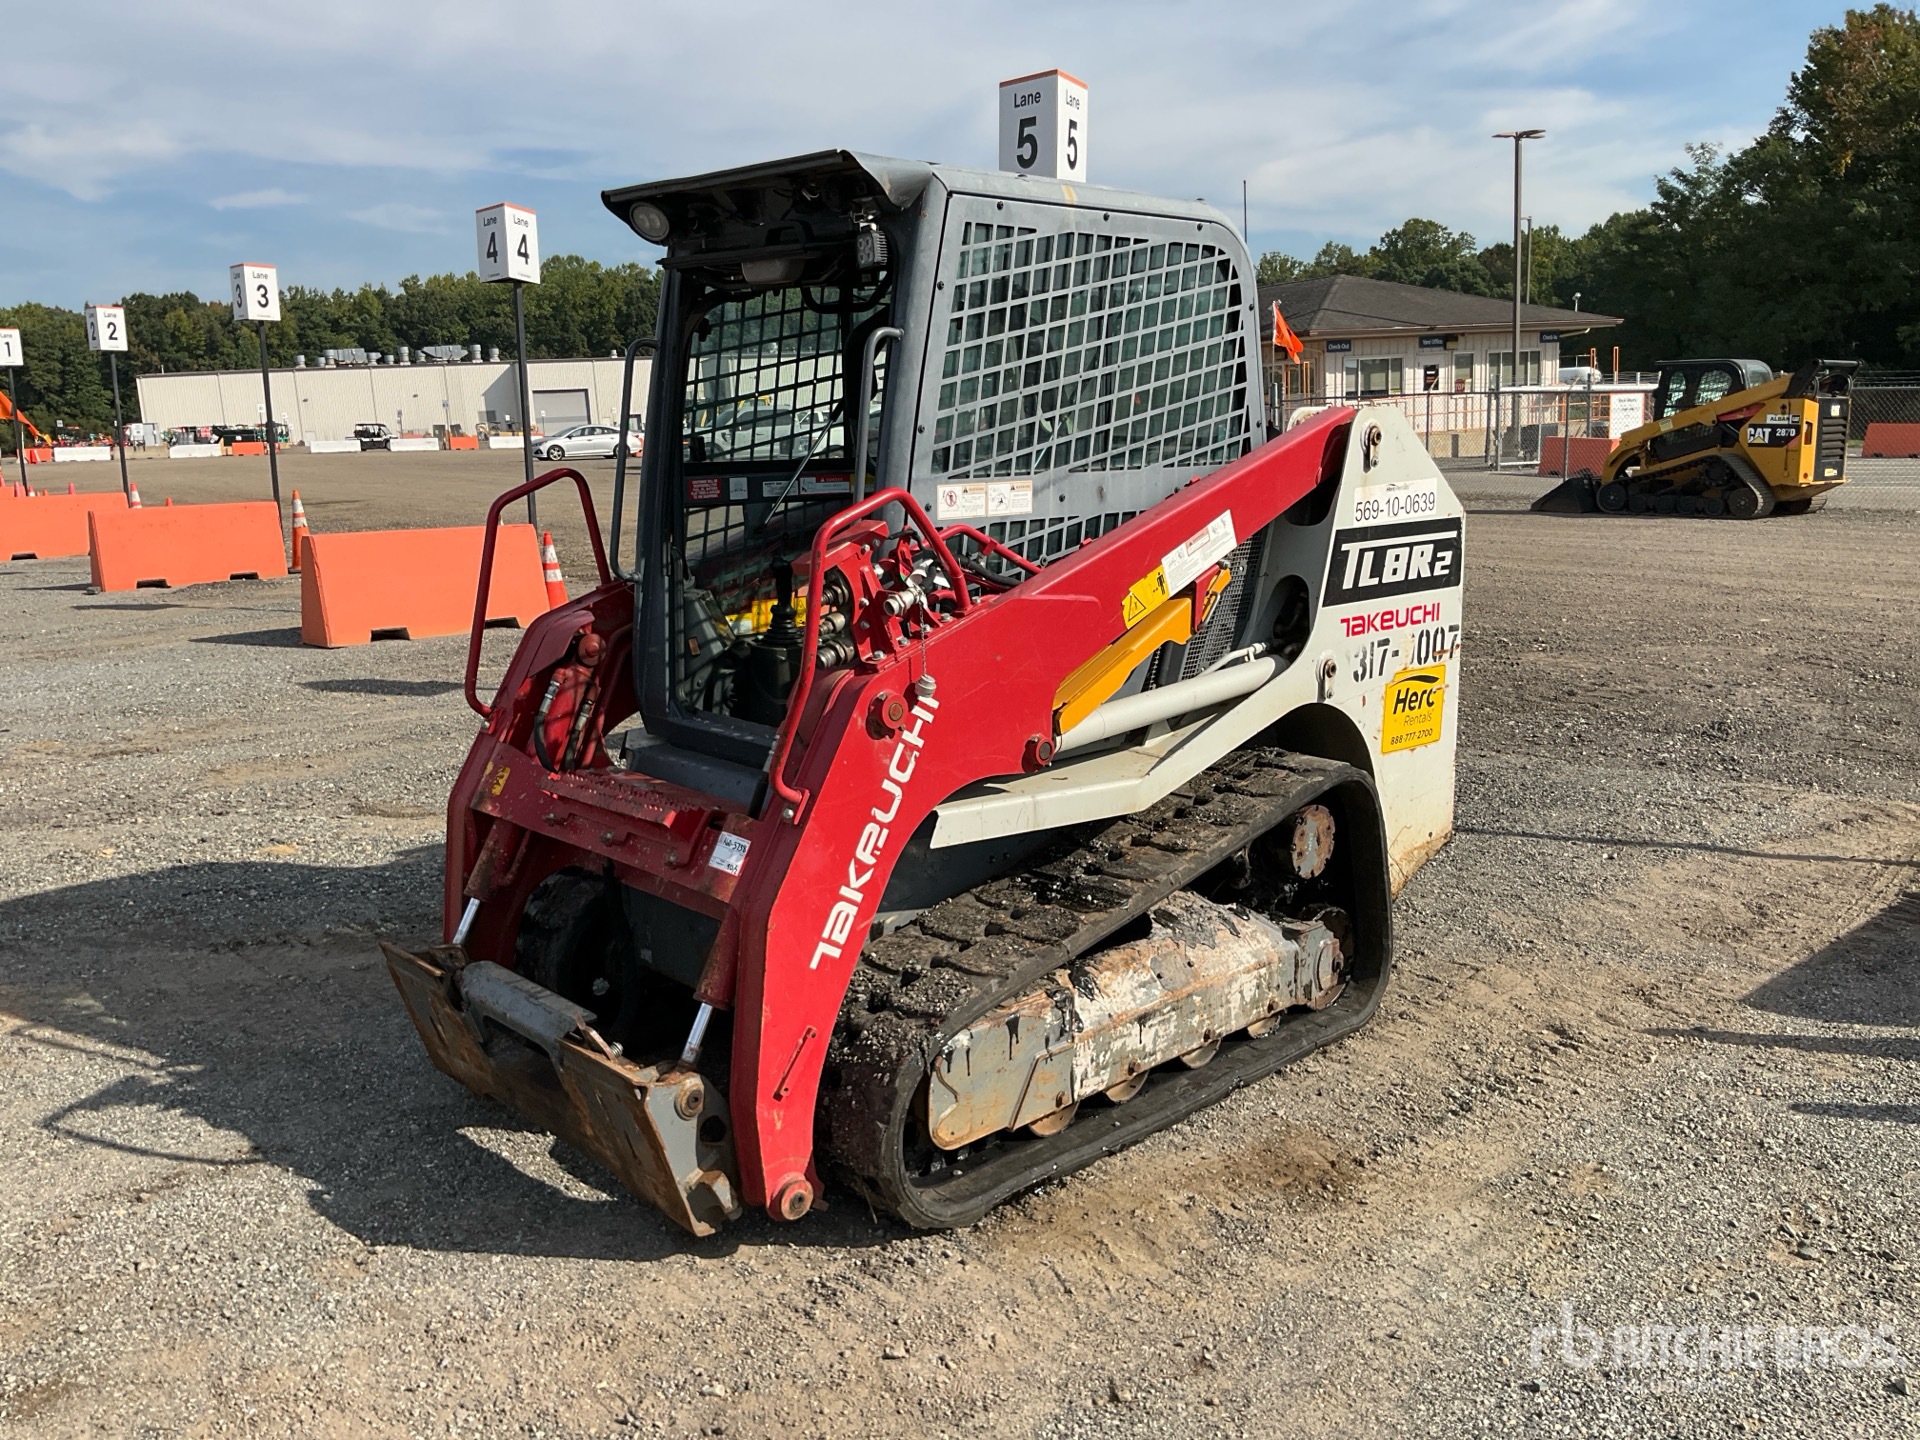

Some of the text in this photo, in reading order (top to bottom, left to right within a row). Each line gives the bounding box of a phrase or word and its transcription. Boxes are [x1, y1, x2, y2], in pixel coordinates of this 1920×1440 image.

[1014, 91, 1041, 108] Lane
[1066, 89, 1080, 110] Lane
[1016, 116, 1038, 169] 5
[1067, 118, 1078, 171] 5
[483, 216, 497, 227] Lane
[513, 214, 529, 228] Lane
[486, 231, 498, 264] 4
[517, 233, 530, 265] 4
[252, 271, 269, 279] Lane
[235, 283, 243, 309] 3
[256, 284, 269, 308] 3
[90, 321, 96, 341] 2
[107, 322, 118, 341] 2
[4, 342, 11, 357] 1
[1747, 427, 1771, 444] CAT
[1776, 428, 1796, 436] 287D
[1355, 492, 1436, 522] 569-10-0639
[1340, 602, 1441, 637] TAKEUCHI
[1353, 623, 1460, 683] 317-007
[1393, 687, 1437, 715] Herc
[1403, 709, 1433, 727] Rentals
[1390, 727, 1434, 746] 888-777-2700
